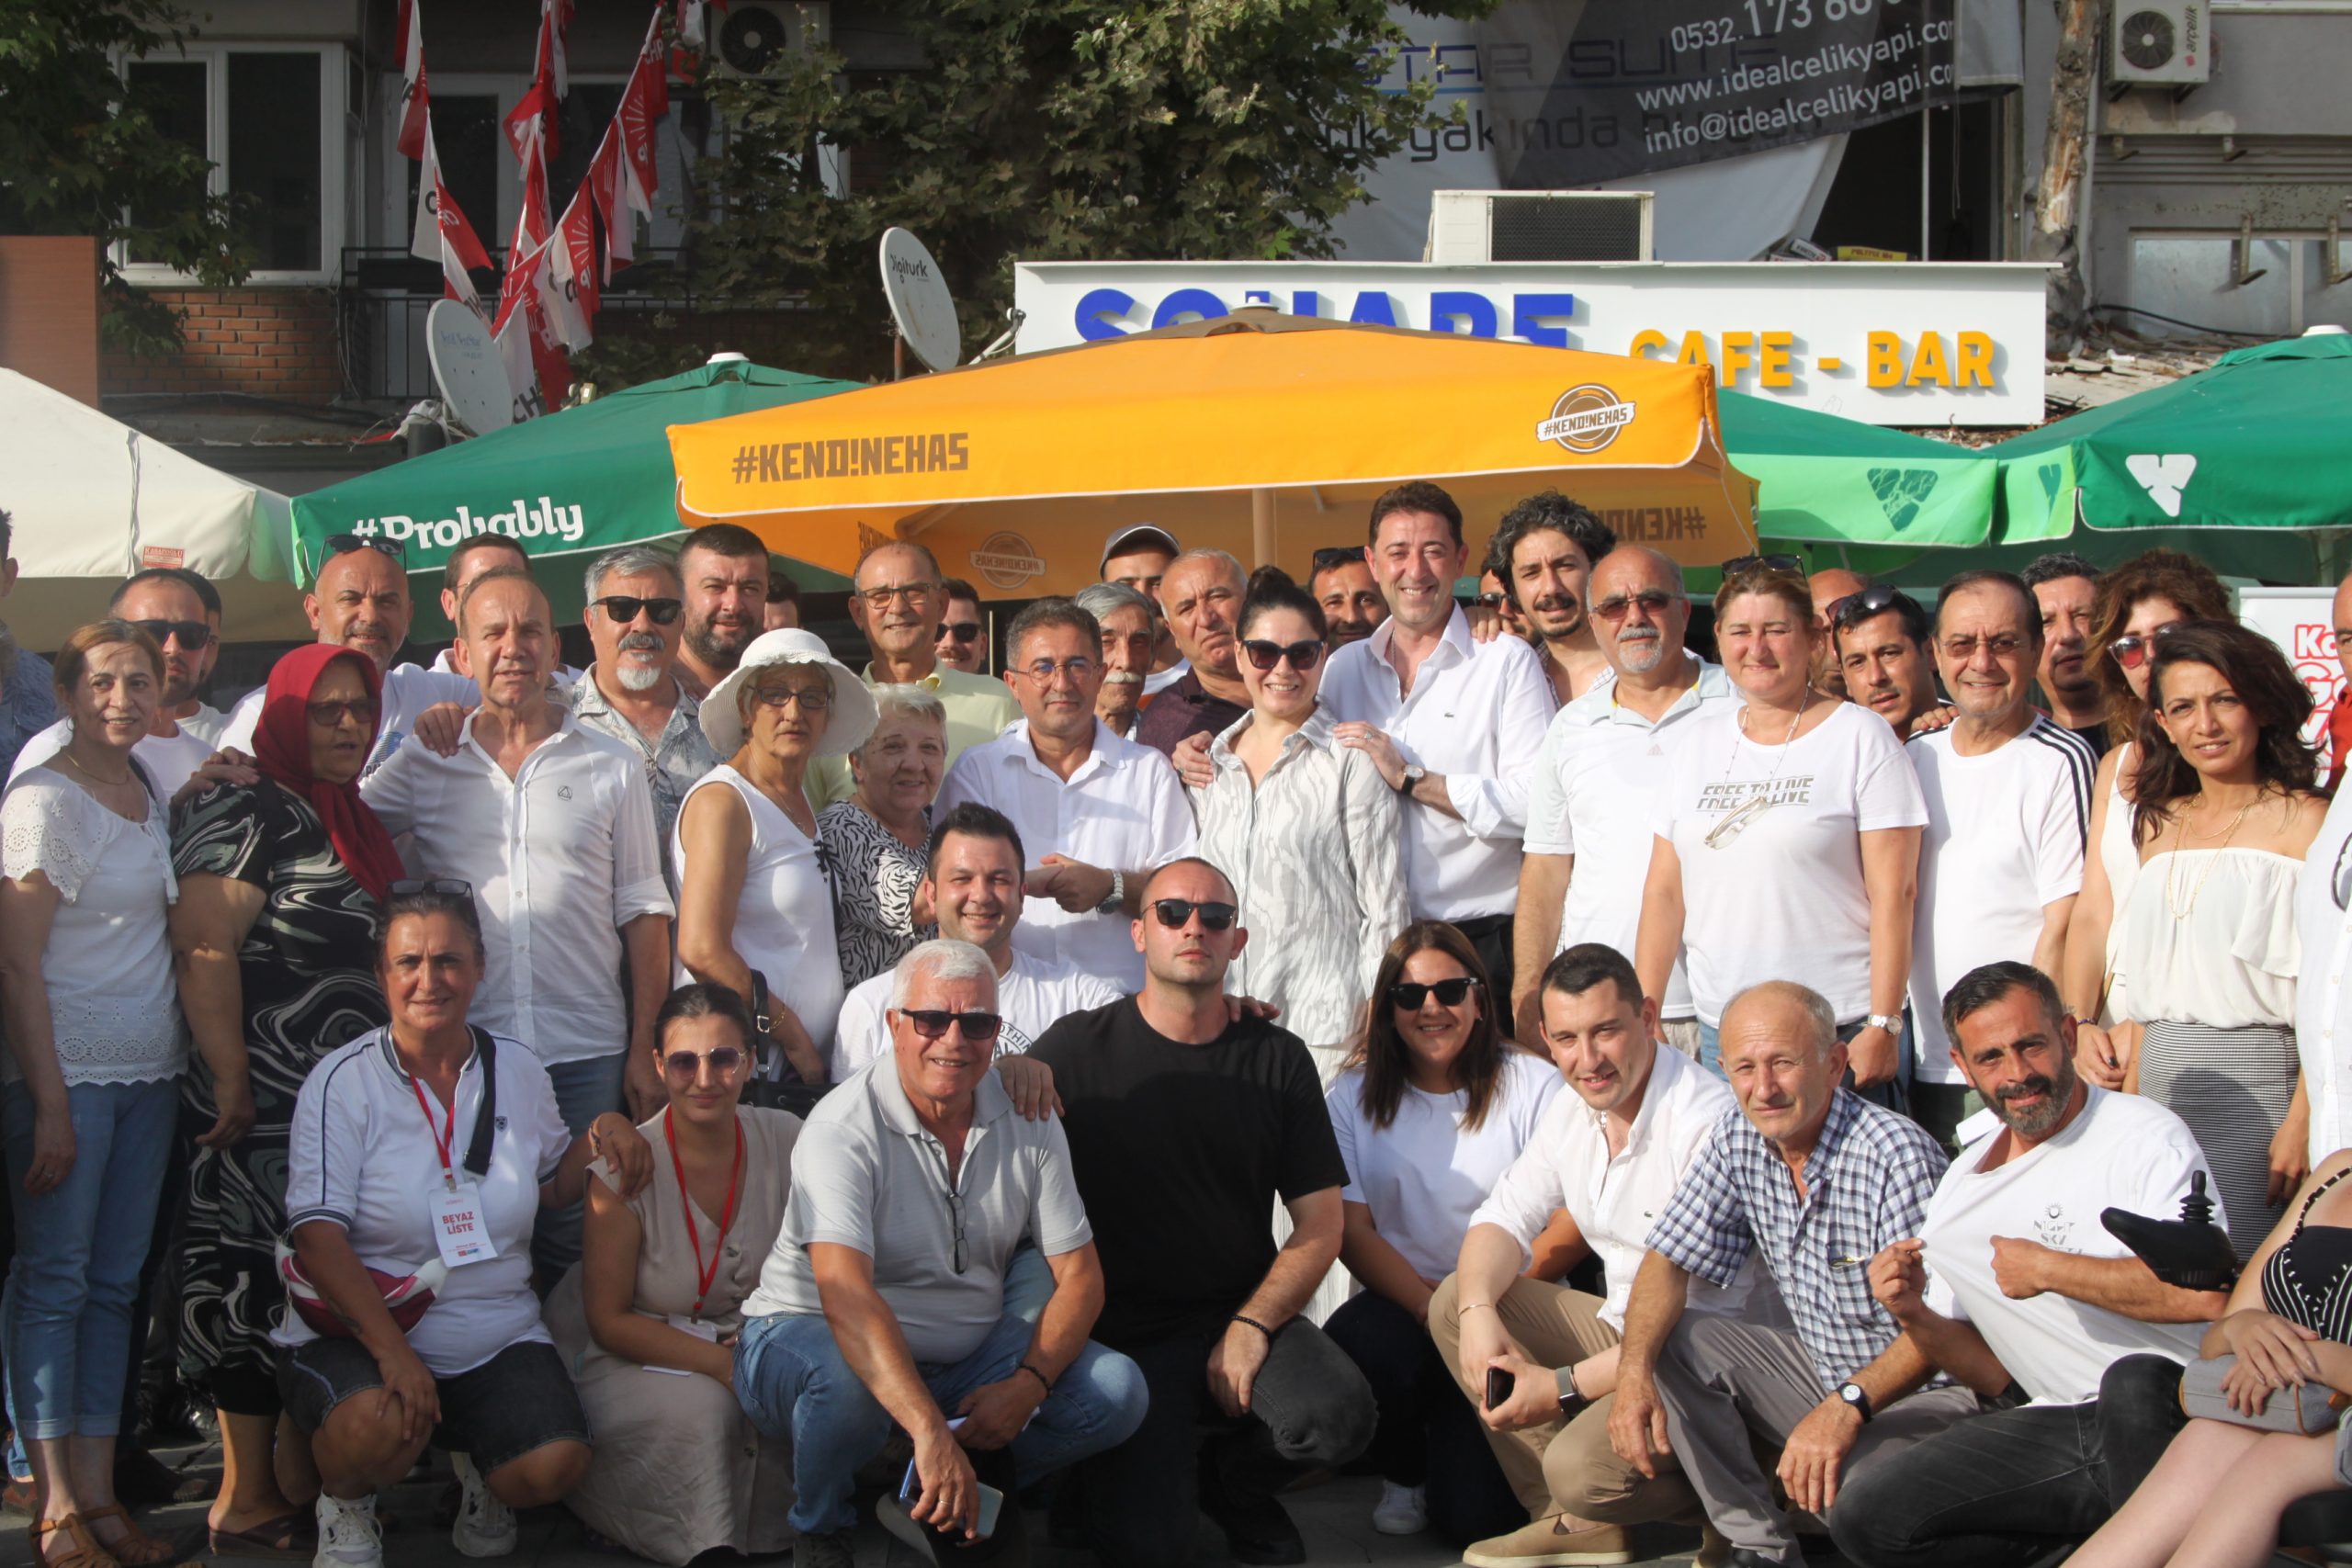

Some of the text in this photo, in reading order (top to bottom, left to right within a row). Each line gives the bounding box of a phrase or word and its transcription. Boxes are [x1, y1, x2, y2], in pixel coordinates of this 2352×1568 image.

[1644, 63, 1954, 154] info@idealcelikyapi.co
[1866, 330, 1996, 388] BAR
[731, 432, 969, 485] #KEND!NEHAS
[351, 496, 585, 550] #Probably
[442, 1211, 475, 1224] BEYAZ
